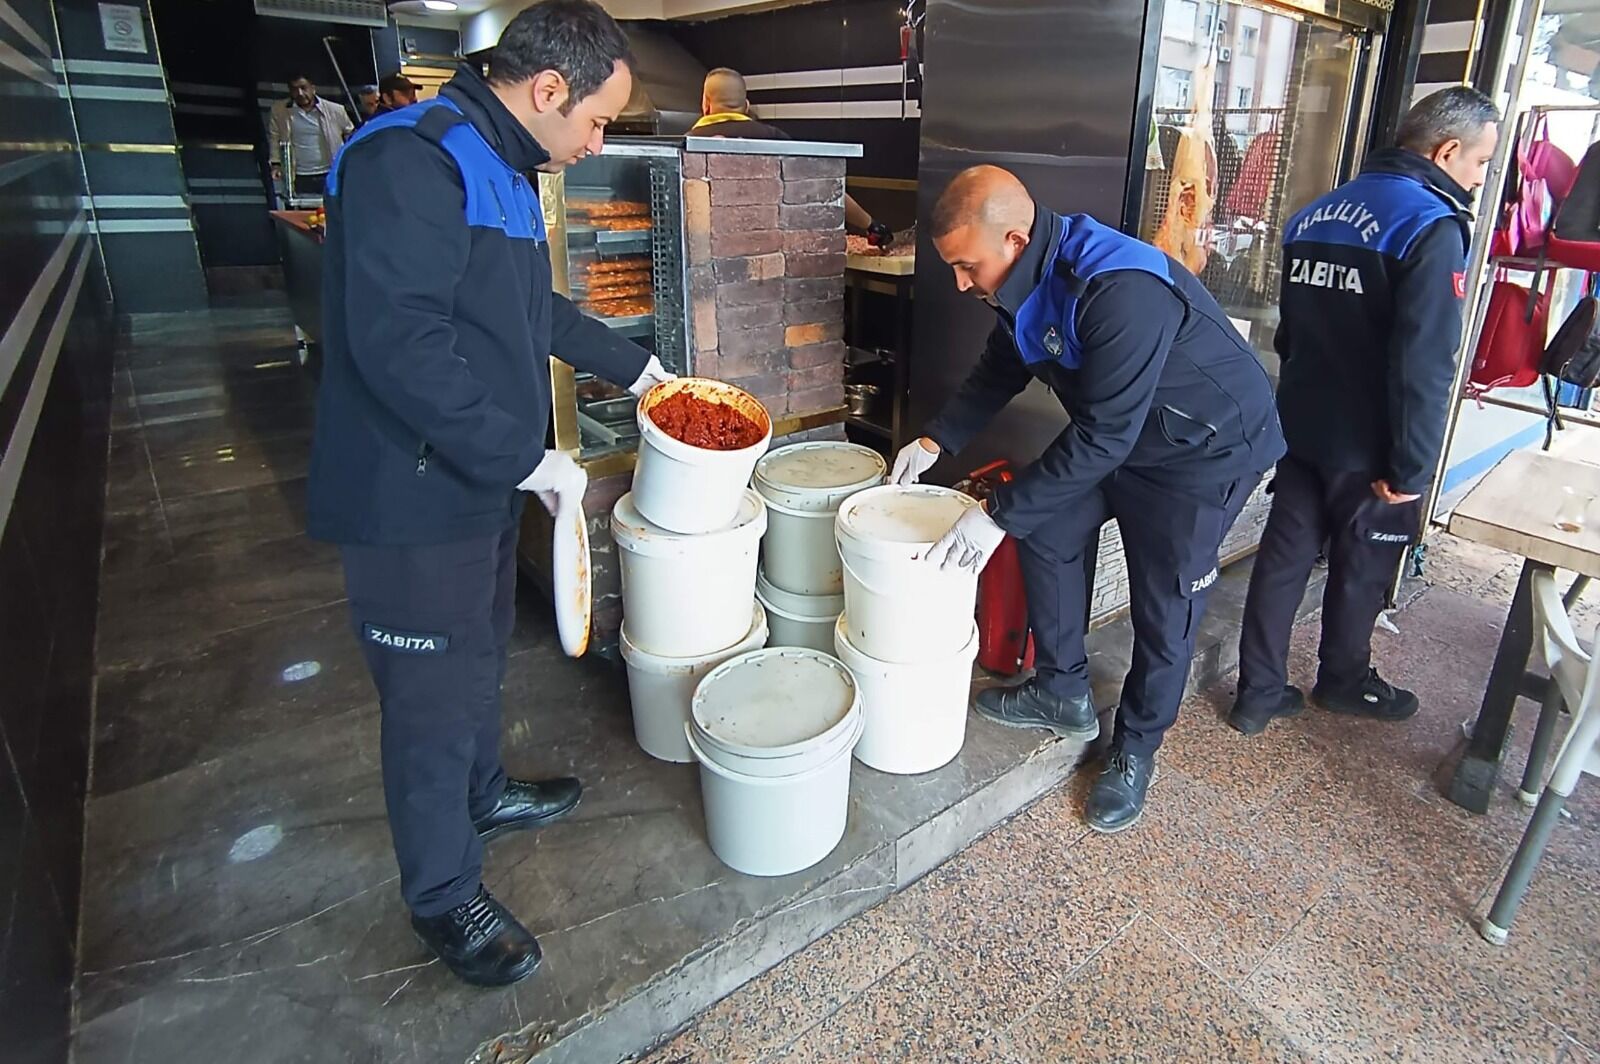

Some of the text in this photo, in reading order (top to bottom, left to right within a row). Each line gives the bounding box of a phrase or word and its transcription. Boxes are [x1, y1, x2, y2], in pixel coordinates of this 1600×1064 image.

[1296, 199, 1381, 243] HALİLİYE
[1289, 258, 1364, 294] ZABITA
[1191, 566, 1218, 593] ZABITA
[371, 629, 435, 650] ZABITA
